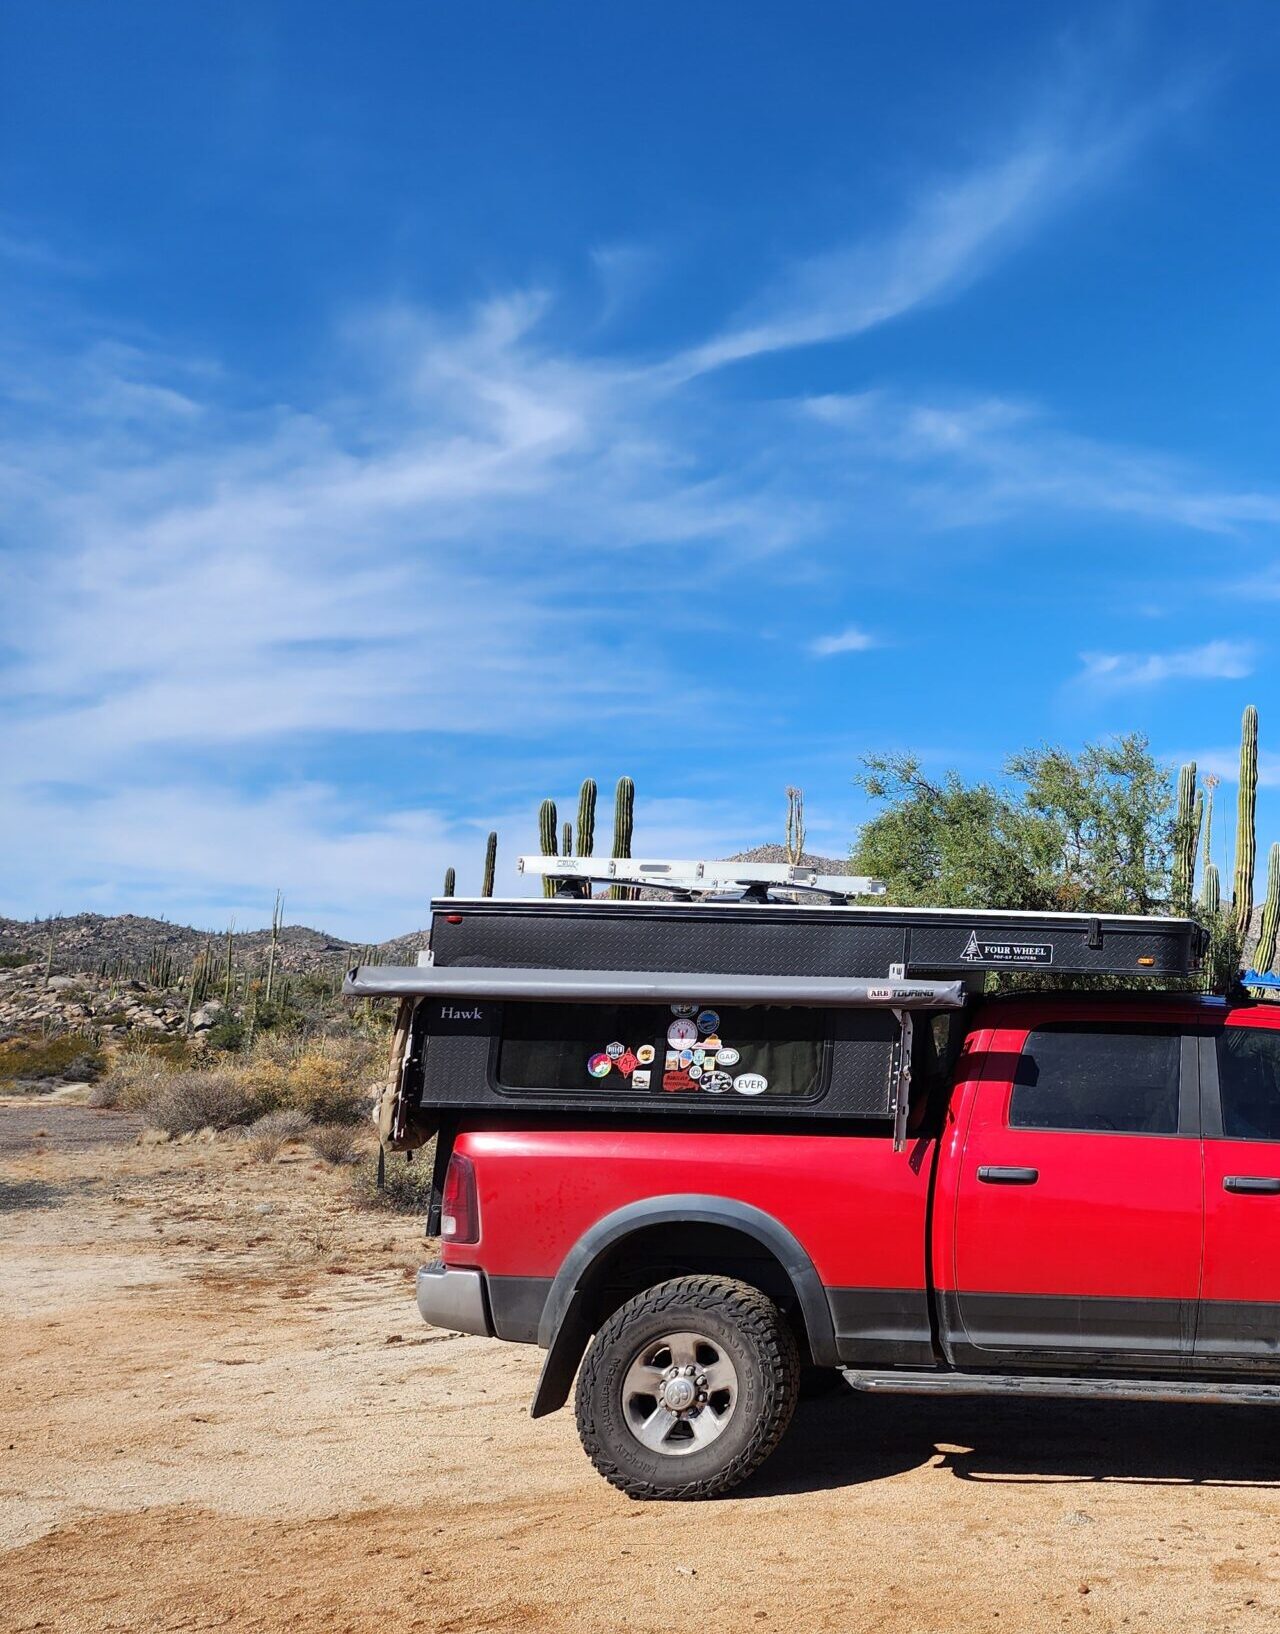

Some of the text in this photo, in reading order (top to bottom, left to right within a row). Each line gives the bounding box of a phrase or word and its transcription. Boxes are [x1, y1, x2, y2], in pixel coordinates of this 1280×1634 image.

[984, 945, 1047, 956] FOUR WHEEL
[892, 989, 935, 997] TOURING
[440, 1006, 484, 1019] Hawk
[737, 1079, 764, 1089] EVER
